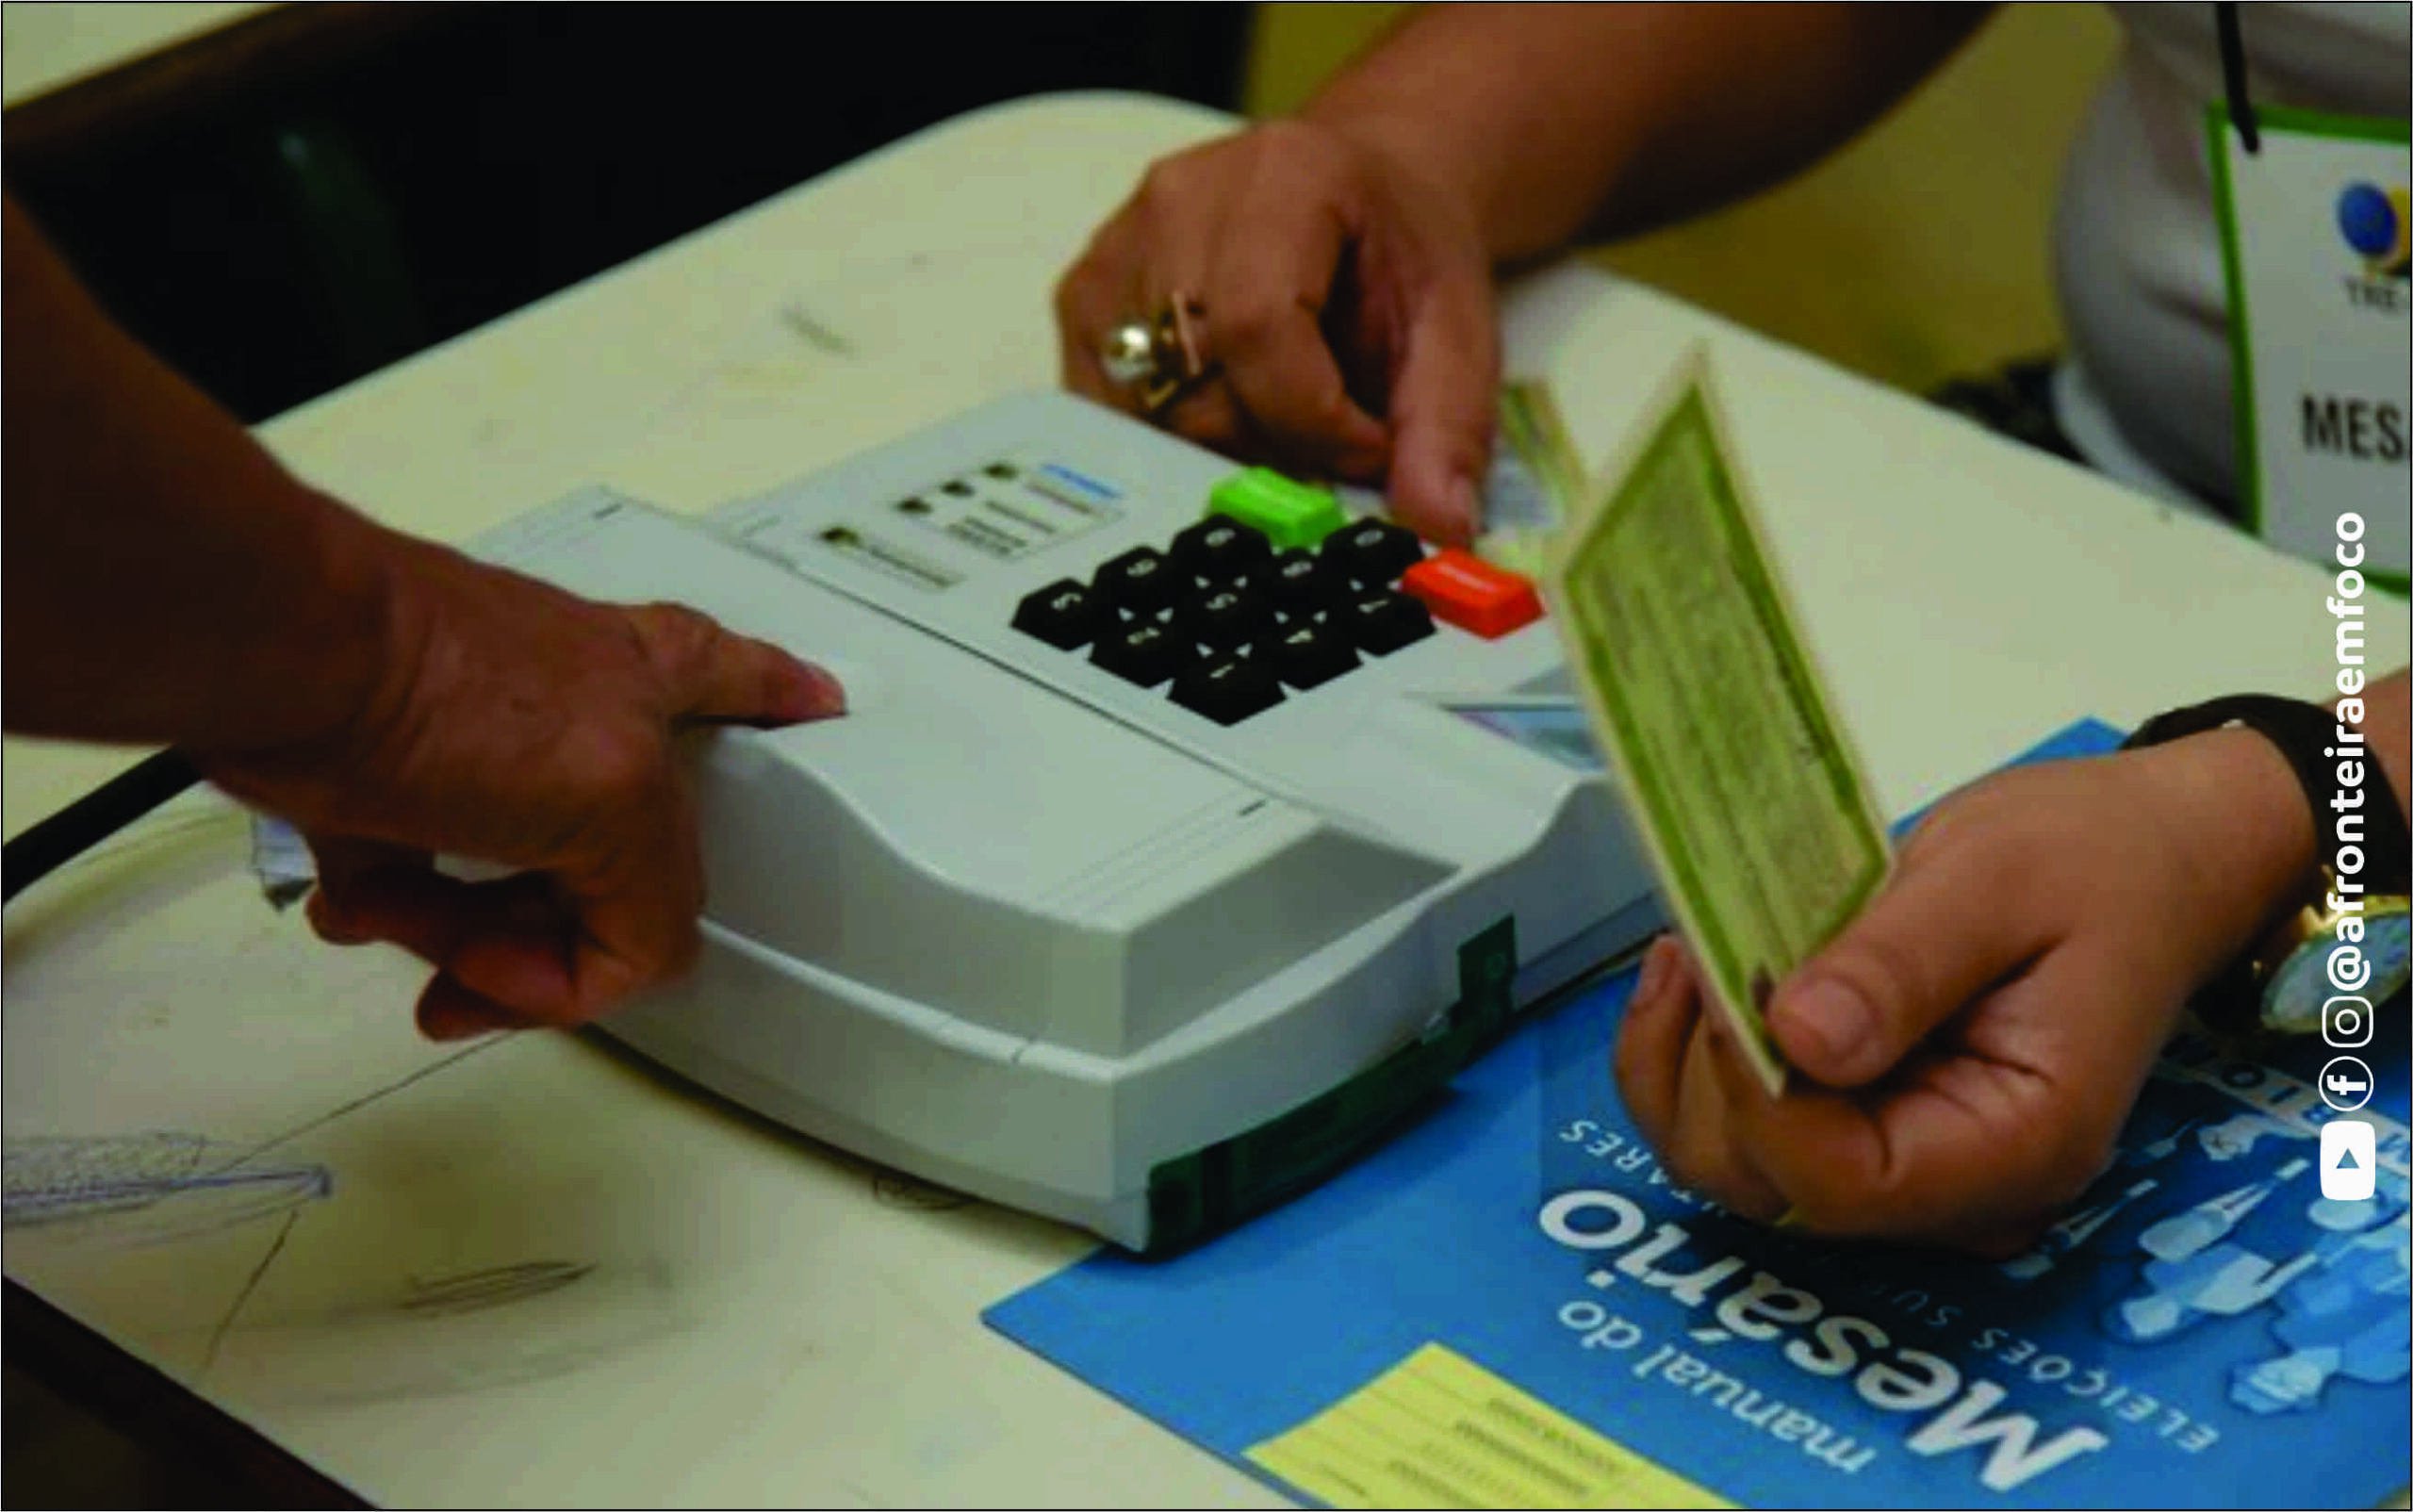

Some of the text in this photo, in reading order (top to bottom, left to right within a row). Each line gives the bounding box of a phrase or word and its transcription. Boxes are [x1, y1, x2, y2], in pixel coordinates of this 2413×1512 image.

[2302, 392, 2410, 463] MES
[1538, 1190, 2109, 1492] Mesário
[1558, 1300, 1642, 1349] do
[1631, 1344, 1877, 1473] manual
